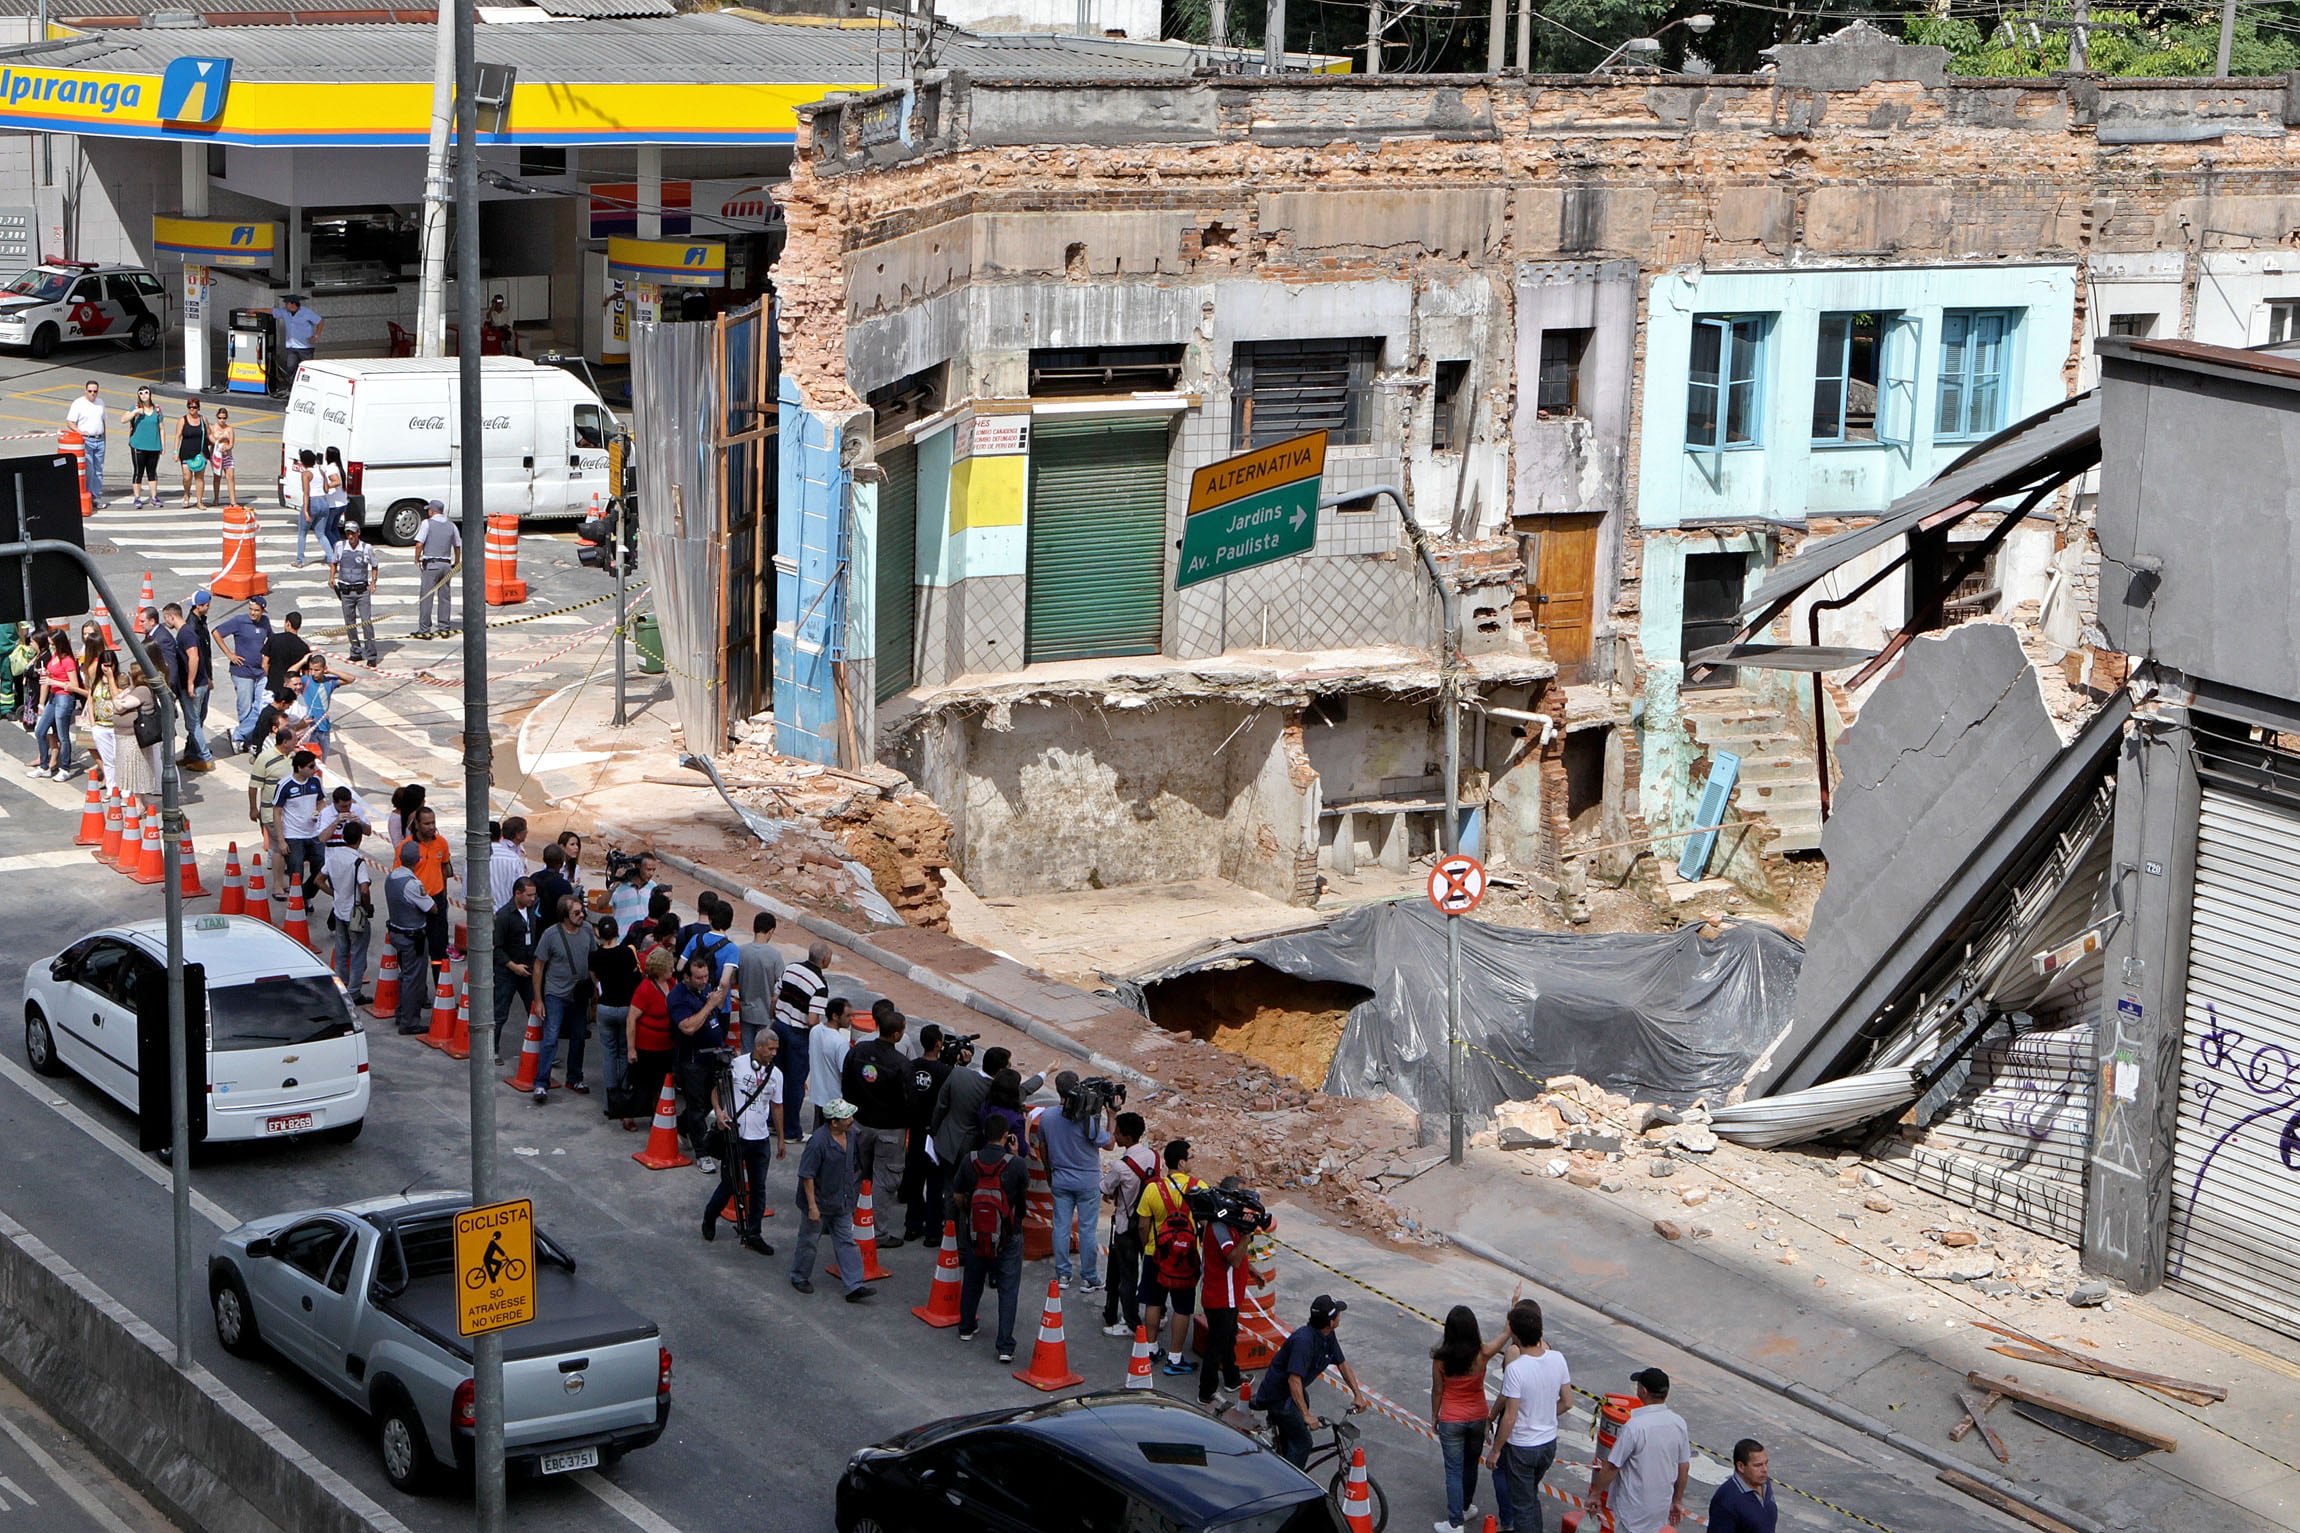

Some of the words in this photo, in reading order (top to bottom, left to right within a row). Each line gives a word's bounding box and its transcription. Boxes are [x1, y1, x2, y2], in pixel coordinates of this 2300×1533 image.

[0, 69, 141, 113] Ipiranga
[721, 200, 785, 226] amp
[1206, 447, 1312, 495] ALTERNATIVA
[1226, 504, 1283, 534] Jardins
[1187, 555, 1211, 574] Av.
[1216, 533, 1280, 564] Paulista
[2147, 862, 2161, 874] 720
[203, 917, 226, 928] TAXI
[459, 1208, 529, 1234] CICLISTA
[468, 1295, 527, 1316] ATRAVESSE
[489, 1286, 505, 1299] SÓ
[472, 1317, 488, 1329] NO
[490, 1309, 523, 1324] VERDE
